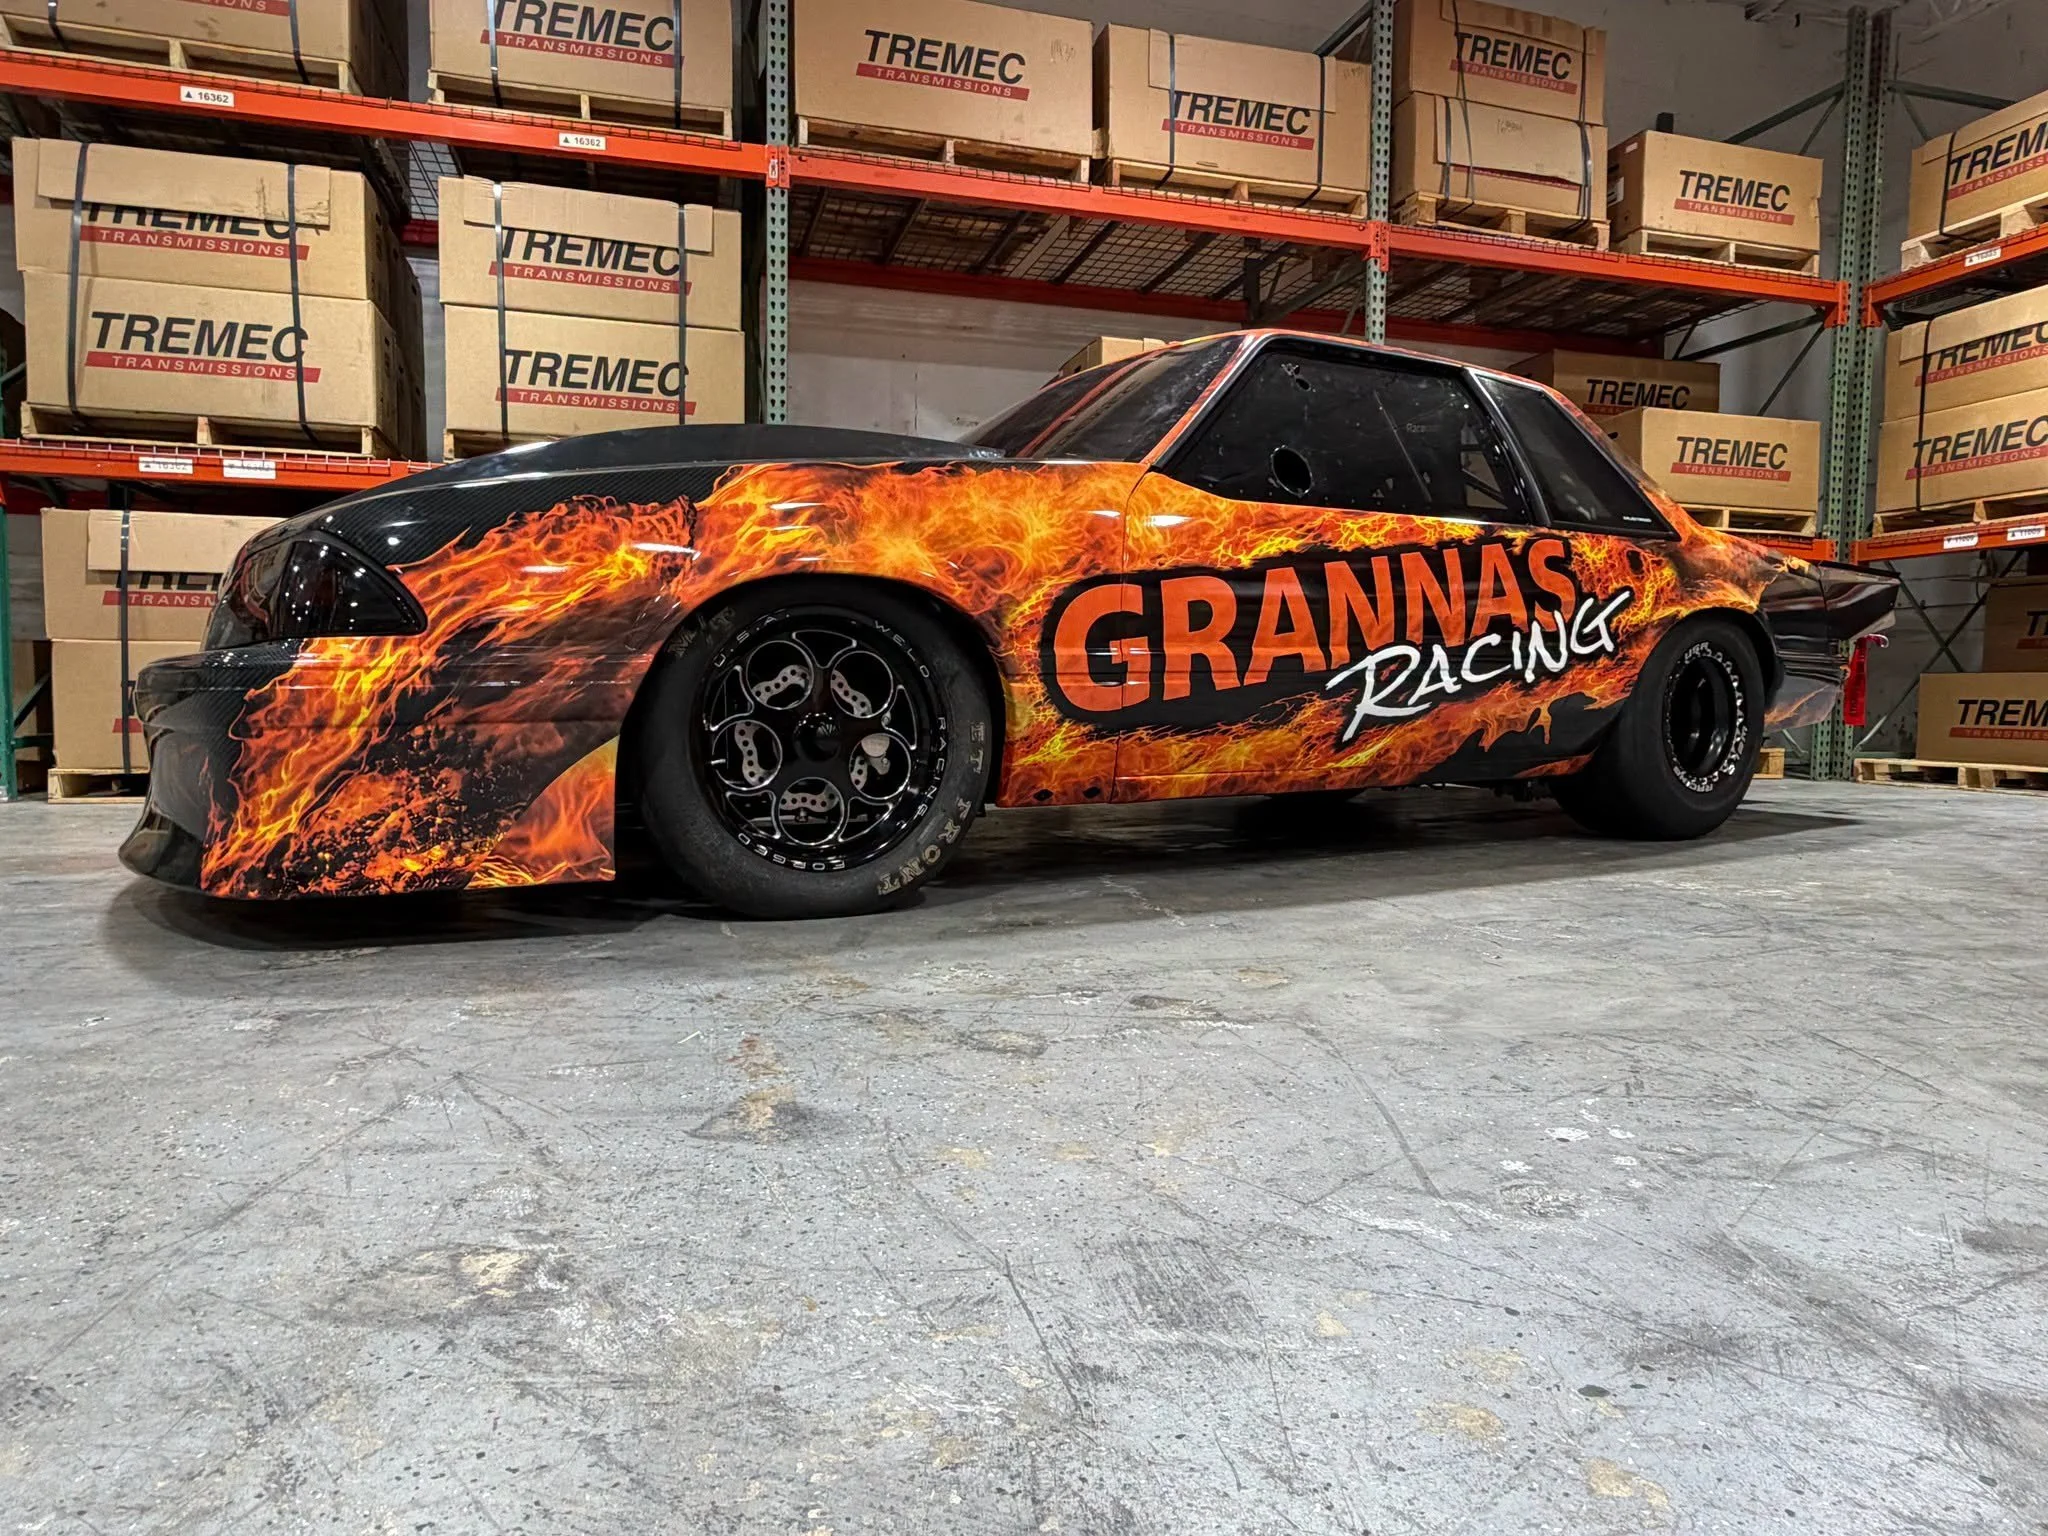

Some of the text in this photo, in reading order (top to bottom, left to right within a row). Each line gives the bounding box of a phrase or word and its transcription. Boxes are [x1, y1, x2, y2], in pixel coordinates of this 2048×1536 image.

[494, 0, 674, 52] TREMEC
[503, 34, 664, 66] TRANSMISSIONS
[864, 29, 1026, 84] TREMEC
[1455, 31, 1572, 80] TREMEC
[198, 91, 229, 104] 16362
[875, 67, 1012, 97] TRANSMISSIONS
[1464, 65, 1566, 91] TRANSMISSIONS
[1173, 90, 1311, 135] TREMEC
[1179, 123, 1300, 147] TRANSMISSIONS
[1950, 121, 2048, 186] TREM
[1679, 169, 1791, 212] TREMEC
[1687, 202, 1783, 223] TRANSMISSIONS
[99, 229, 285, 257] TRANSMISSIONS
[512, 265, 672, 292] TRANSMISSIONS
[91, 310, 309, 364] TREMEC
[111, 355, 298, 380] TRANSMISSIONS
[504, 348, 690, 397] TREMEC
[518, 391, 676, 413] TRANSMISSIONS
[1586, 378, 1691, 409] TREMEC
[1676, 435, 1788, 470] TREMEC
[1913, 414, 2048, 469] TREMEC
[1920, 447, 2042, 475] TRANSMISSIONS
[1684, 464, 1781, 480] TRANSMISSIONS
[1053, 538, 1576, 712] GRANNAS
[873, 619, 930, 679] WELD
[1325, 590, 1631, 742] RACING
[917, 716, 947, 818] RACING
[876, 720, 986, 896] ET FRONT
[737, 831, 846, 872] FORGED
